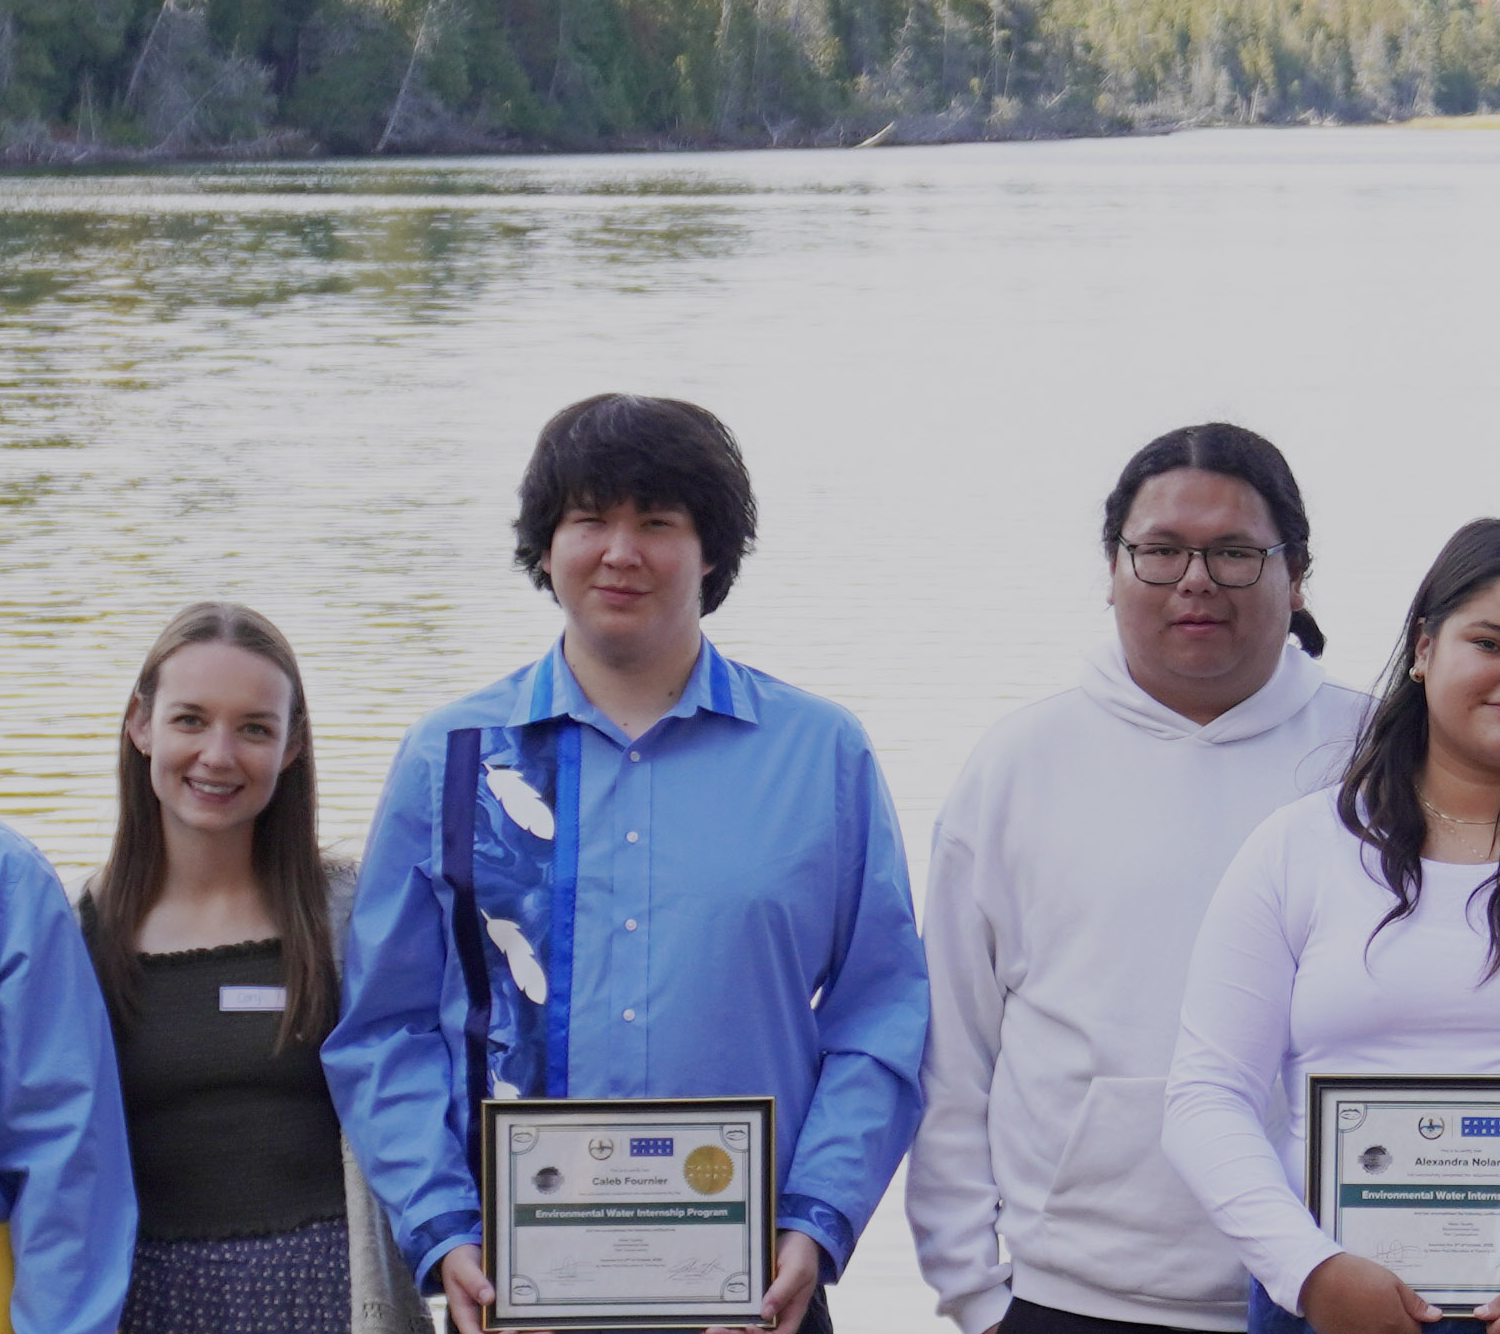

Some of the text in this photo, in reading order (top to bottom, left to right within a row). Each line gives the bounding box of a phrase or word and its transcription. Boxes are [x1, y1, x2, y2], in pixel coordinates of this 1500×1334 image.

[1414, 1157, 1469, 1167] Alexandra
[592, 1175, 669, 1186] Caleb Fournier
[1361, 1190, 1434, 1200] Environmental
[1436, 1190, 1465, 1201] Water
[535, 1208, 728, 1219] Environmental Water Internship Program
